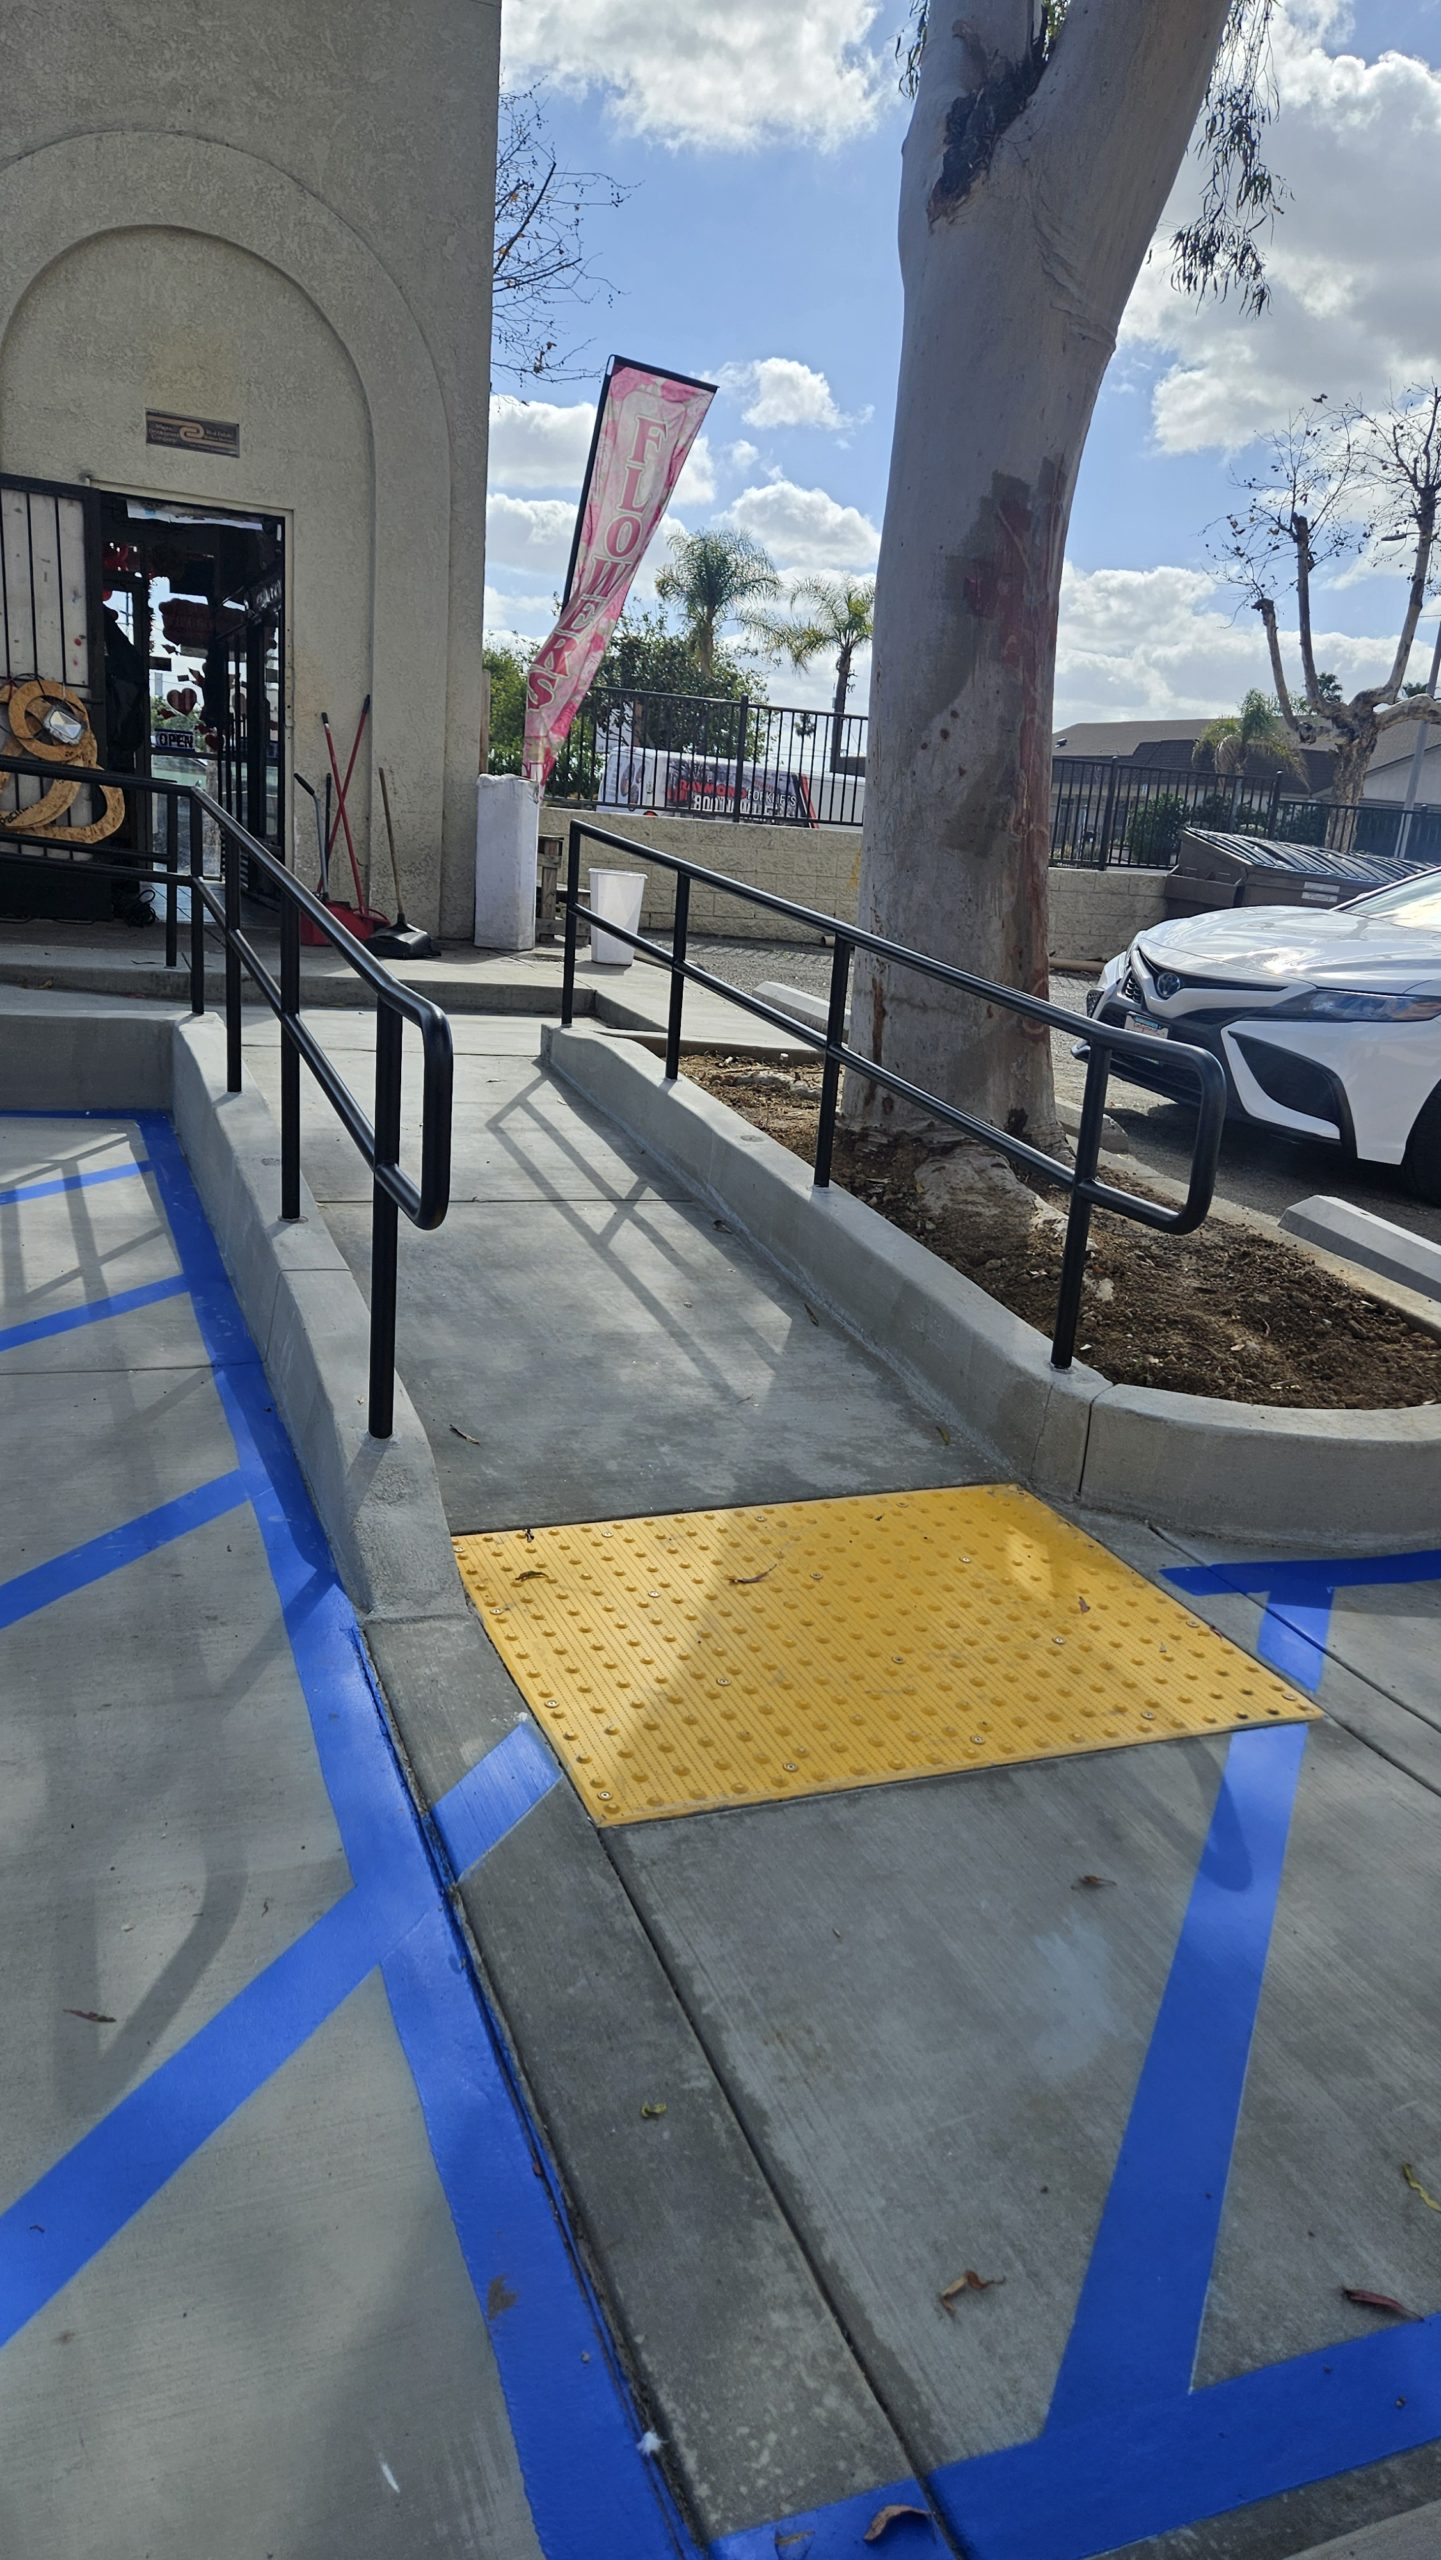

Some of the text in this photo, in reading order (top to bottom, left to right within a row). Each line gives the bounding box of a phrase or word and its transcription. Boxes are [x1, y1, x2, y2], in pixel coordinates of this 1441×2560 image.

[527, 415, 668, 711] FLOWERS
[159, 733, 193, 747] OPEN
[747, 789, 797, 807] FORKLIFS
